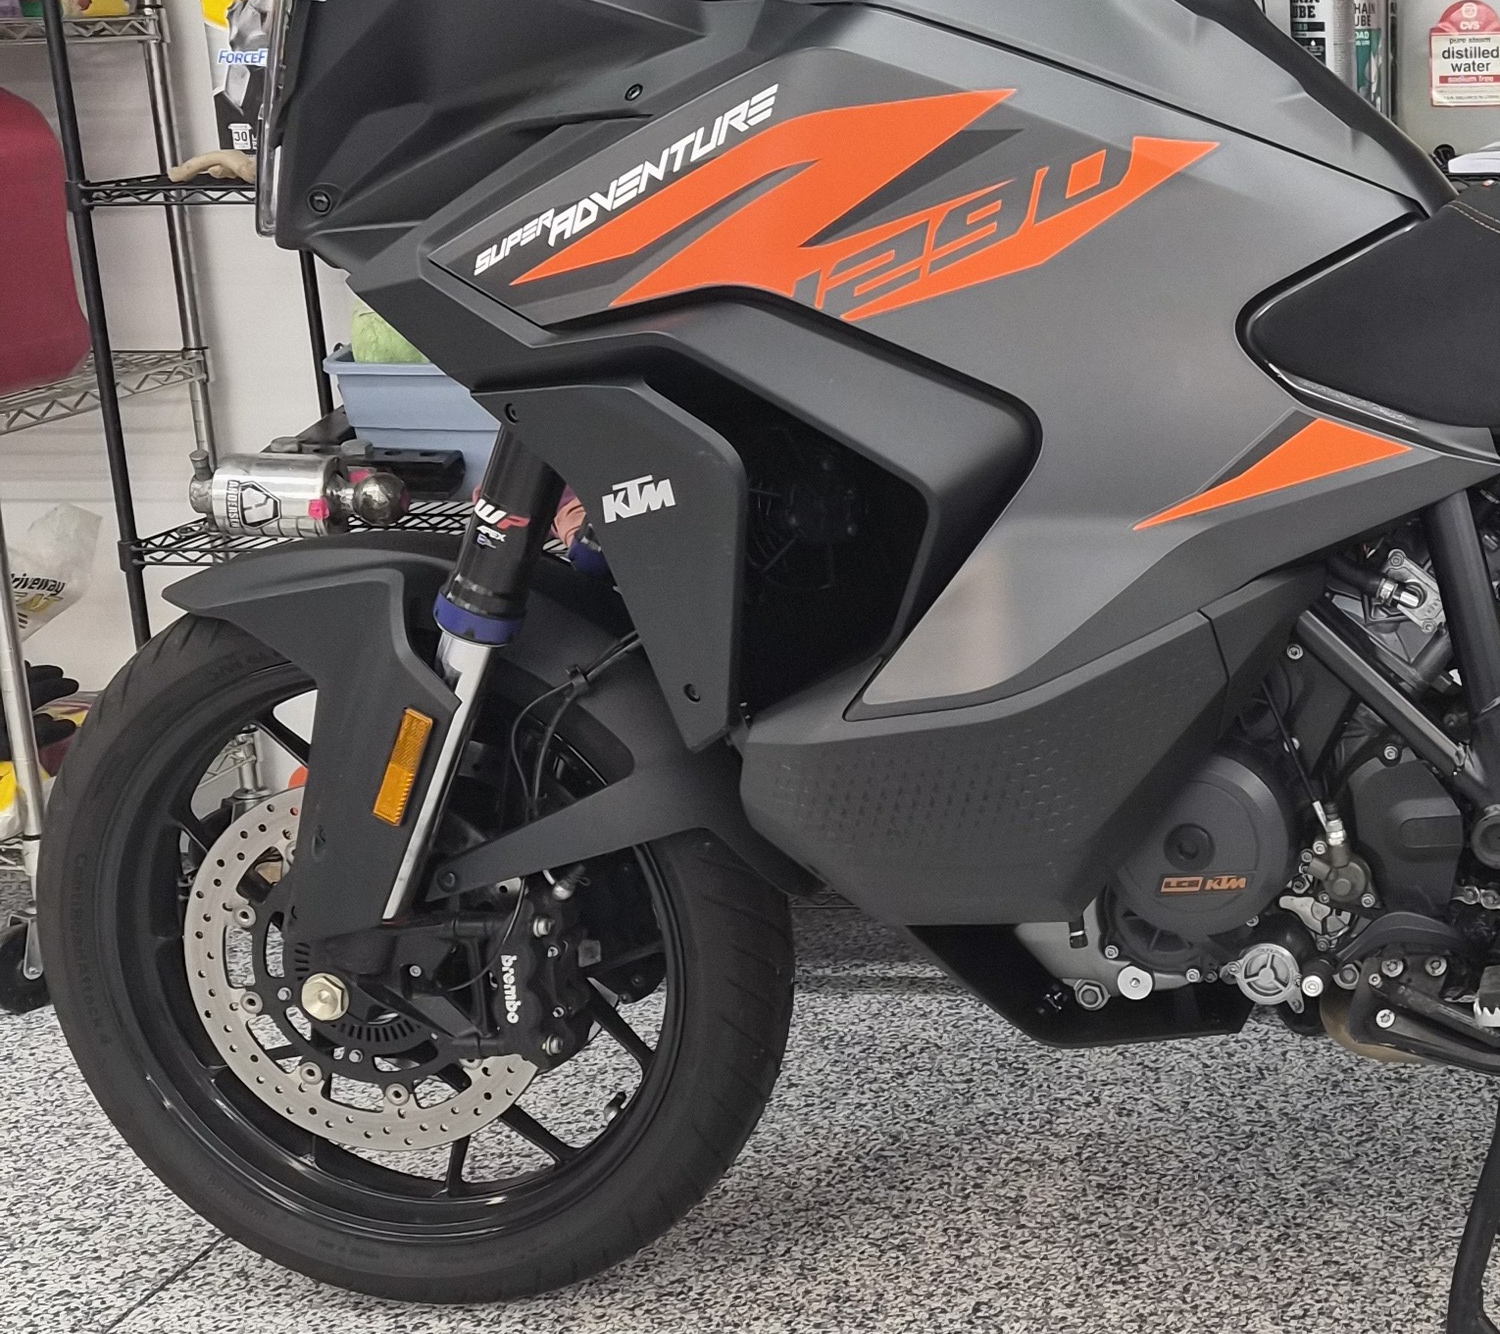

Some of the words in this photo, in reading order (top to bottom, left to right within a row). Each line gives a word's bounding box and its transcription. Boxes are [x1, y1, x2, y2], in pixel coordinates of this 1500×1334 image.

[1291, 5, 1316, 18] UBE
[1354, 2, 1376, 14] HAIN
[1355, 15, 1371, 26] UBE
[1460, 21, 1480, 30] CVS
[1355, 31, 1370, 39] OAD
[218, 49, 268, 64] FORCEF
[1441, 46, 1500, 60] distilled
[1450, 61, 1491, 72] water
[474, 208, 555, 276] SUPER
[548, 83, 779, 247] ADVENTURE
[792, 142, 1133, 321] 1290
[602, 474, 676, 524] KTM
[477, 525, 507, 543] APEX
[11, 573, 66, 597] riveway
[1204, 875, 1247, 891] KTM
[500, 954, 521, 1024] brembo
